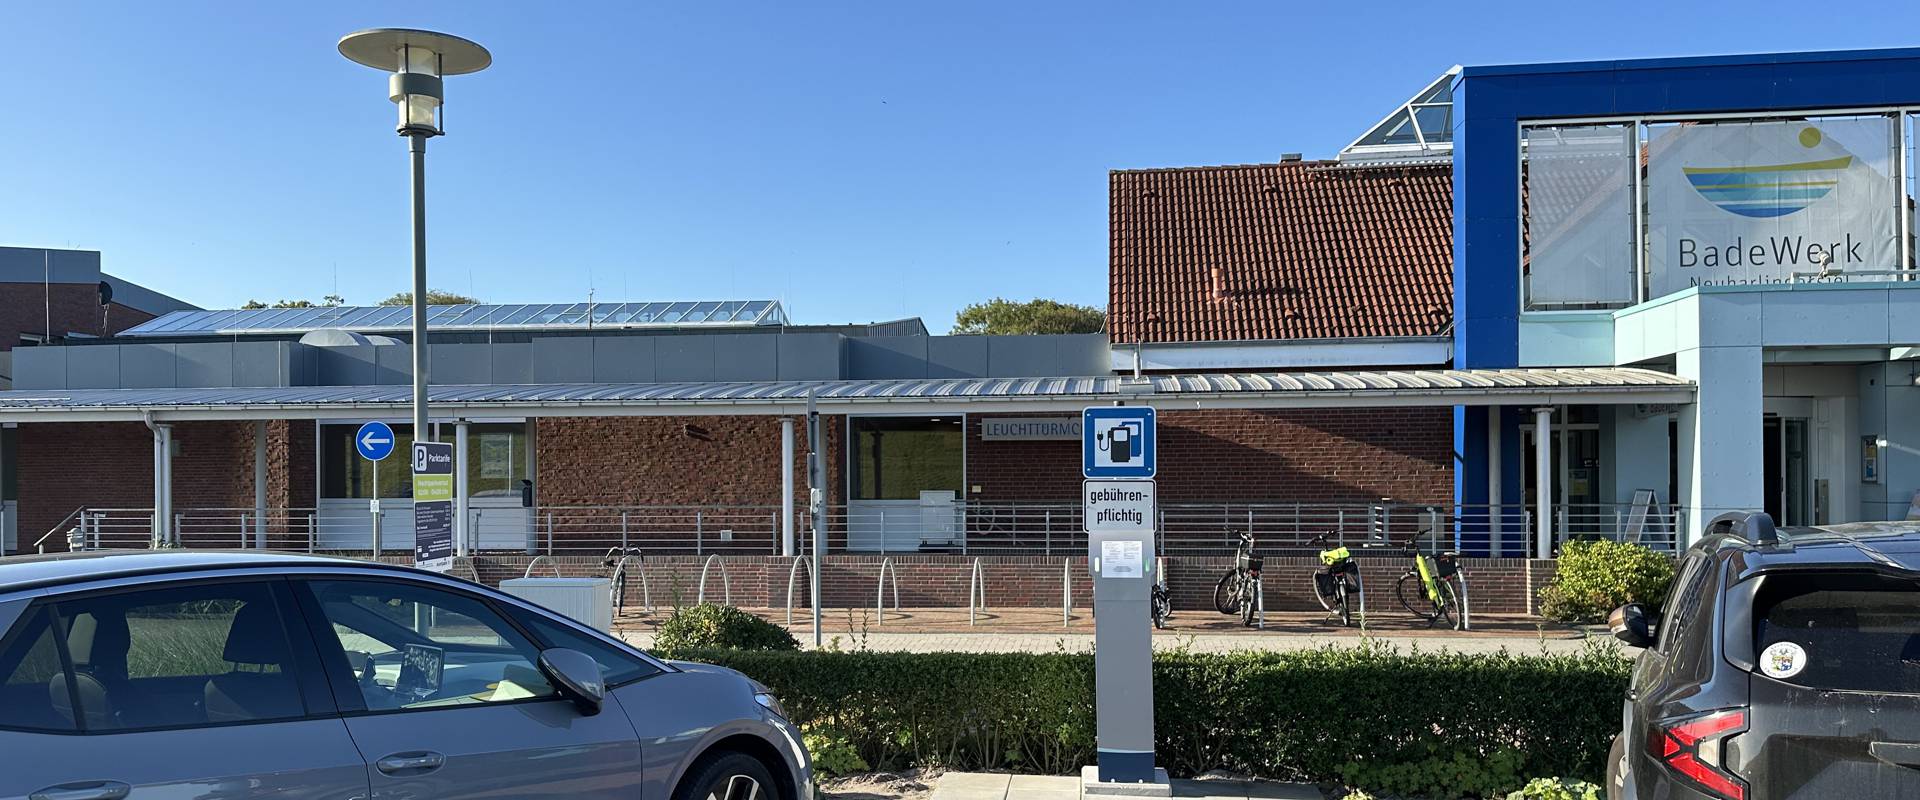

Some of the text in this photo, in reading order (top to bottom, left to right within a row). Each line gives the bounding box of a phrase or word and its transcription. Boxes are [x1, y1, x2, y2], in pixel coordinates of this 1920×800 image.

[1679, 233, 1863, 267] BadeWerk
[986, 422, 1083, 437] LEUCHTTÜRMC
[1090, 488, 1149, 504] gebühren-
[1097, 508, 1142, 525] pflichtig
